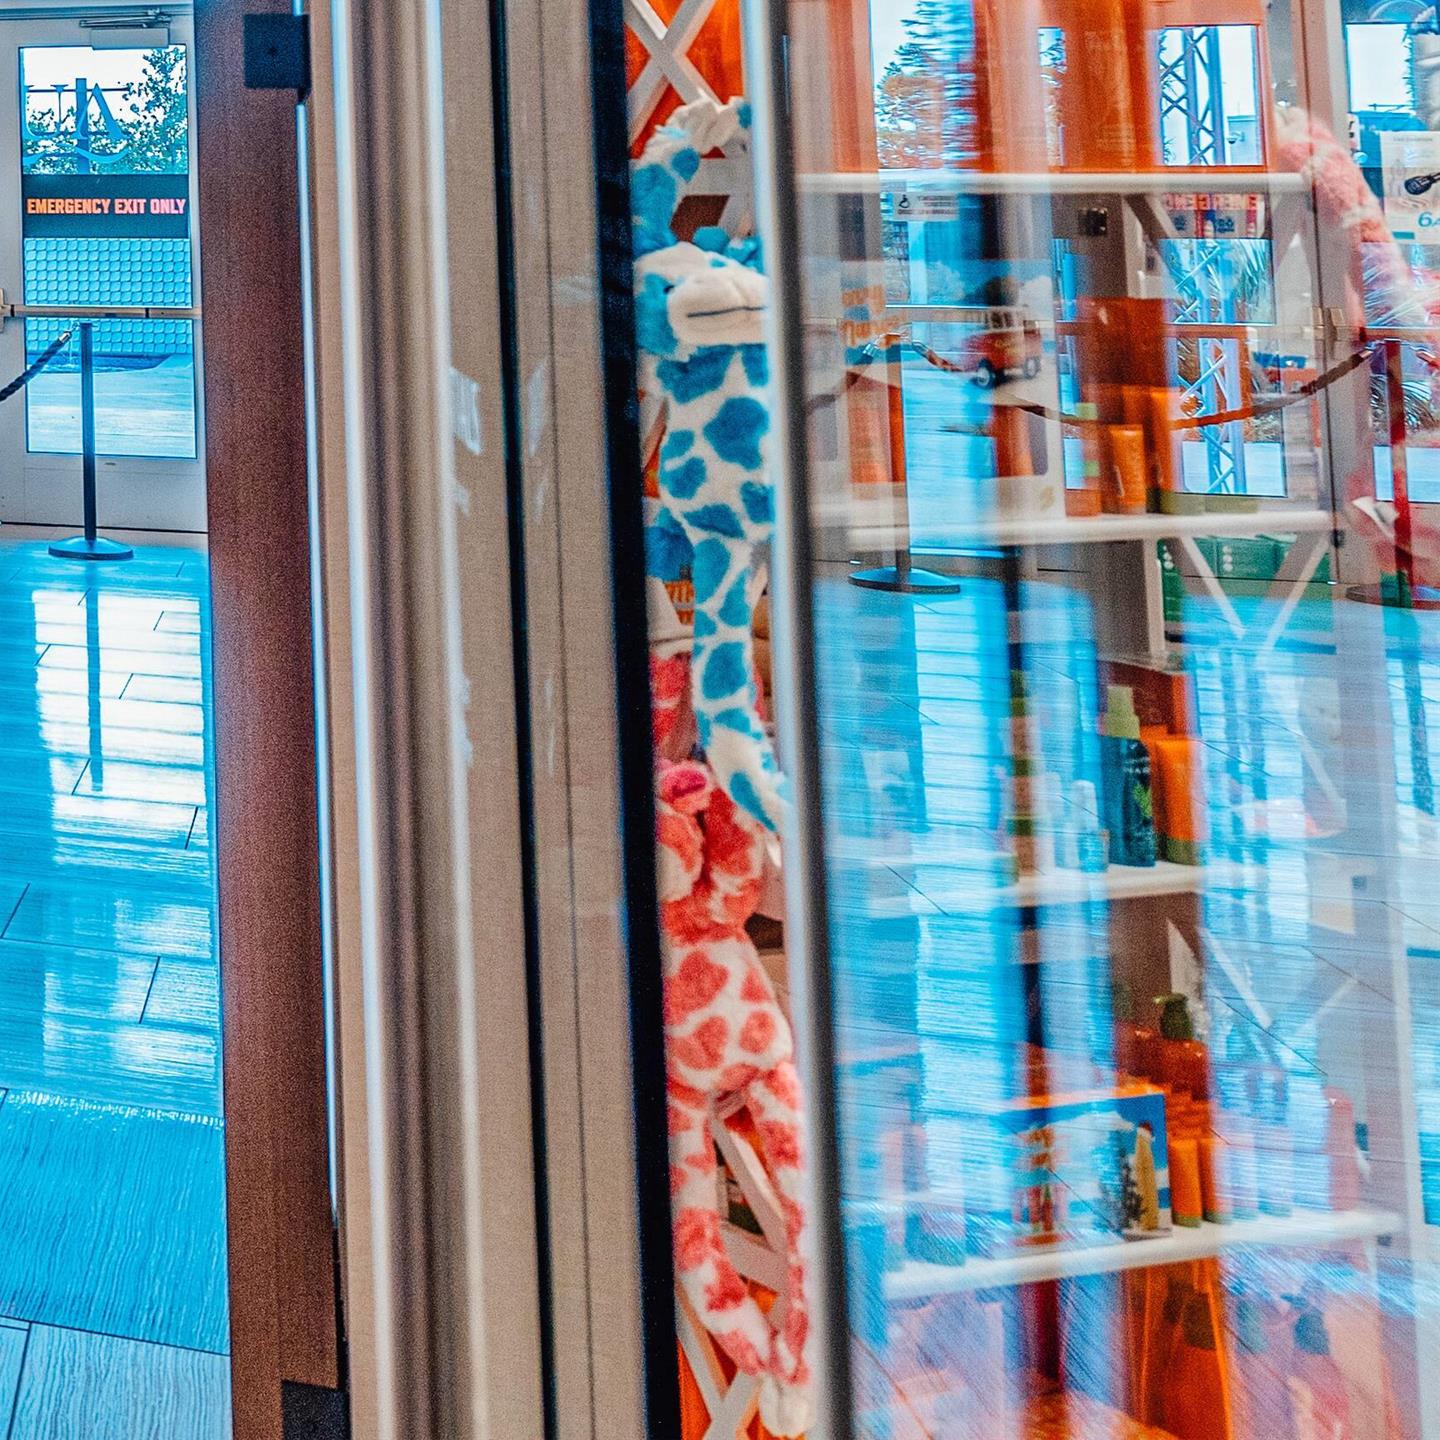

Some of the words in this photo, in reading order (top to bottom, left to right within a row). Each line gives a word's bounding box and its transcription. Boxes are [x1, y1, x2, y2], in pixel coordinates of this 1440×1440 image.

[27, 198, 111, 214] EMERGENCY
[114, 198, 147, 214] EXIT
[150, 198, 187, 214] ONLY
